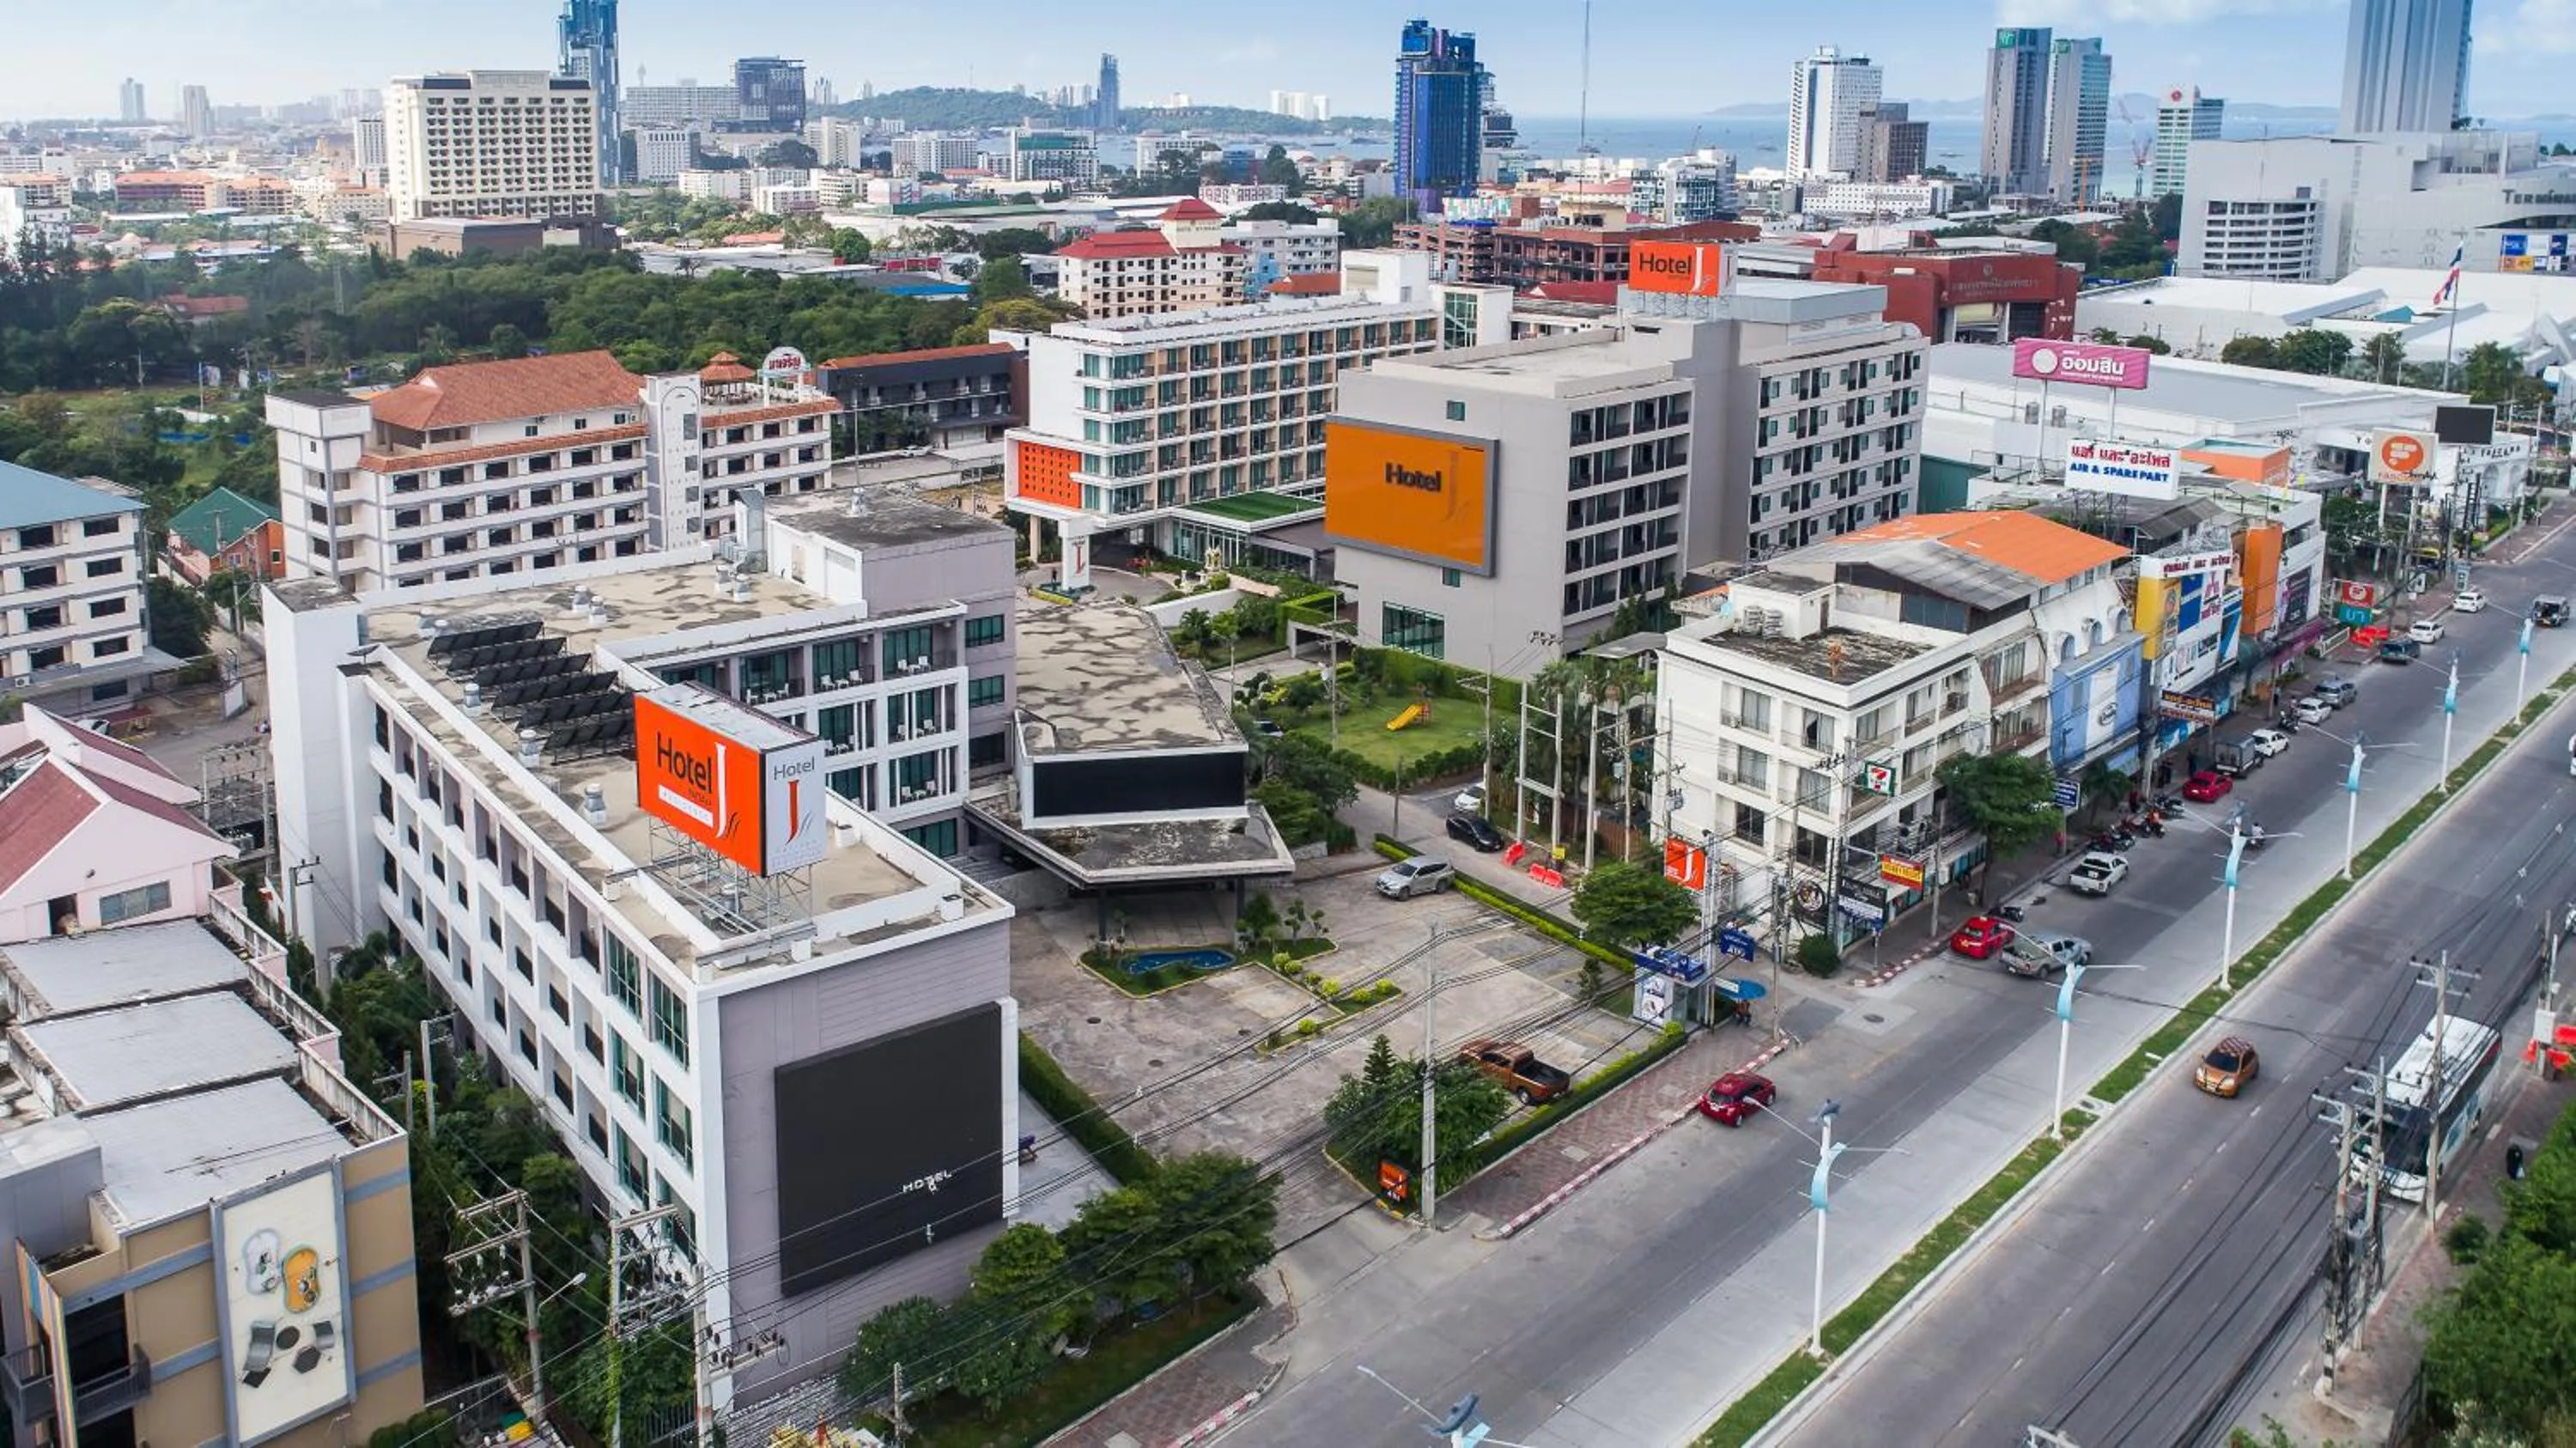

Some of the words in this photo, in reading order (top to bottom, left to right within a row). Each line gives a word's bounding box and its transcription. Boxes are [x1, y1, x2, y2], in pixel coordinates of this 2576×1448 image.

[1639, 252, 1692, 275] Hotel
[2062, 356, 2125, 375] ออมสิน
[1385, 462, 1442, 492] Hotel
[2069, 463, 2088, 473] AIR
[2103, 466, 2138, 478] SPARE
[2139, 470, 2169, 482] PART
[774, 756, 815, 780] Hotel
[657, 731, 712, 794] Hotel
[714, 742, 727, 838] J
